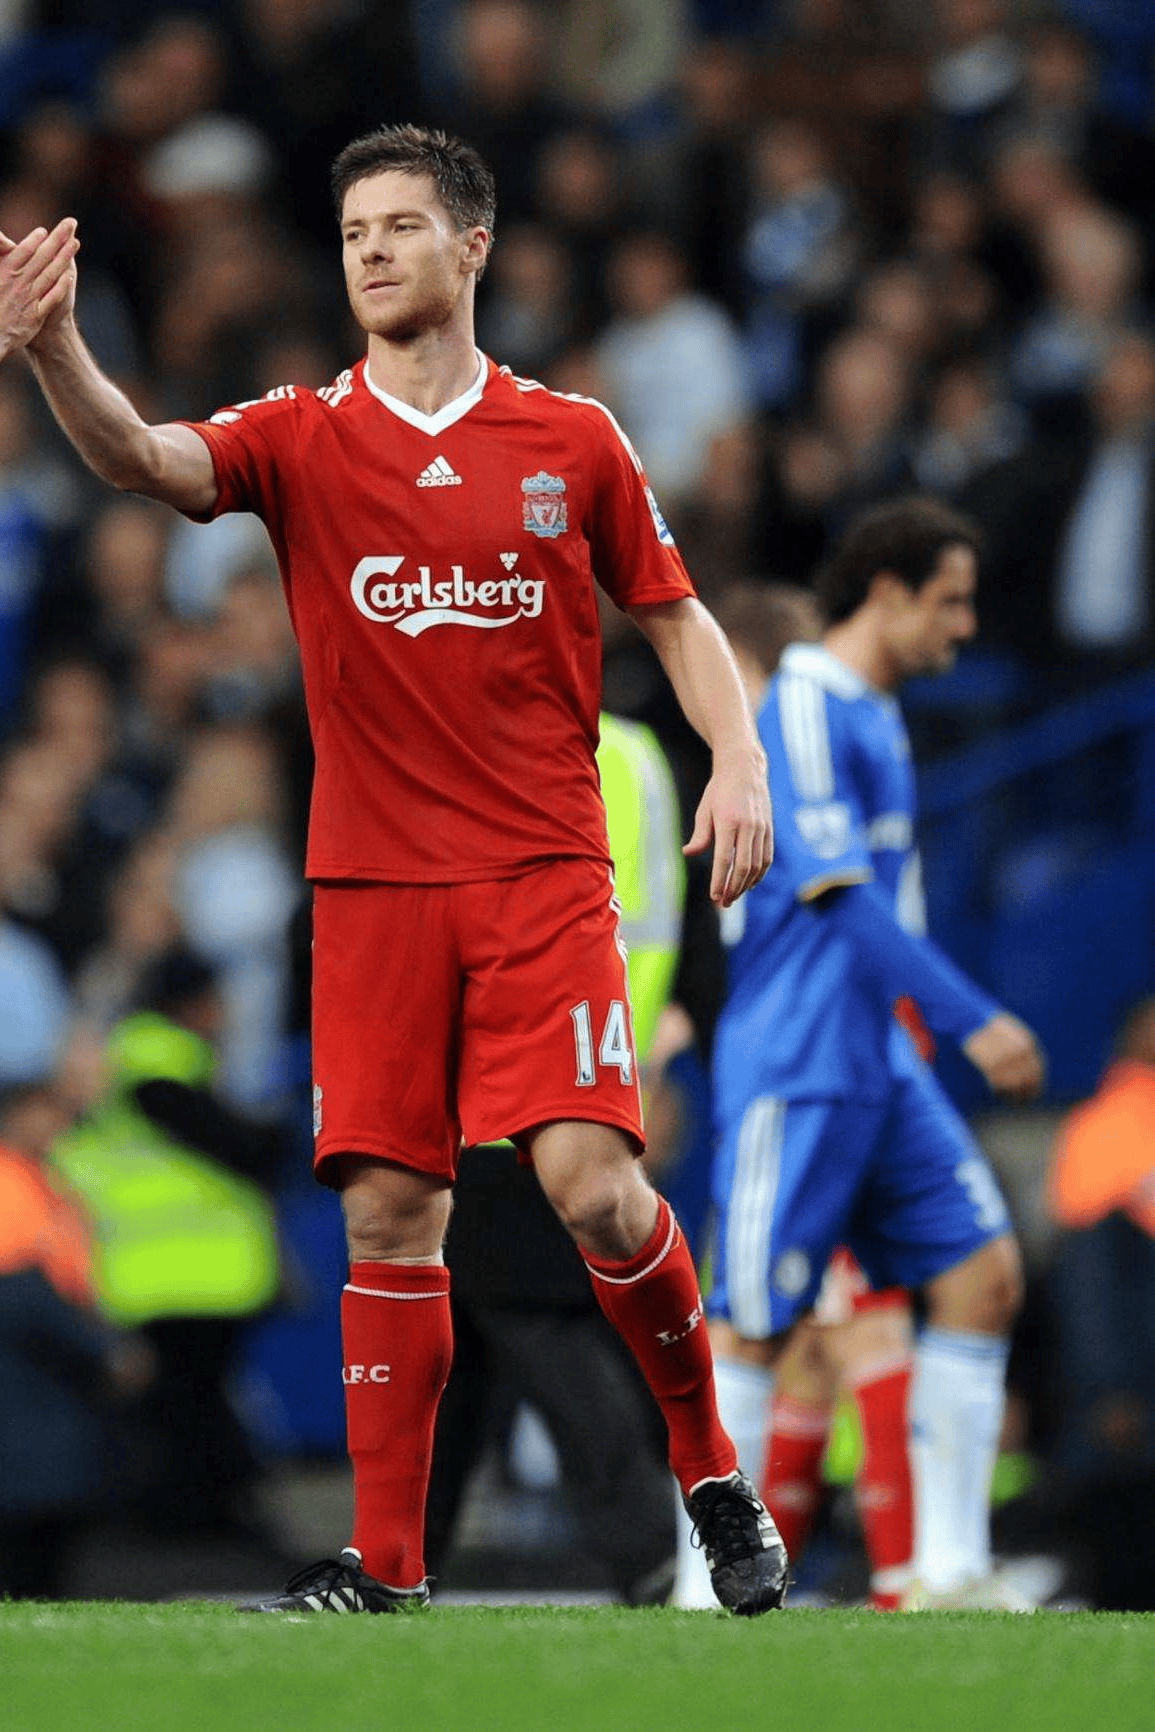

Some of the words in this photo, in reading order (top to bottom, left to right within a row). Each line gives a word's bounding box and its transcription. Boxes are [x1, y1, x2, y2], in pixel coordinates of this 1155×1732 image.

[416, 475, 463, 488] adidas
[350, 556, 546, 623] Carlsberg
[569, 1000, 633, 1087] 14
